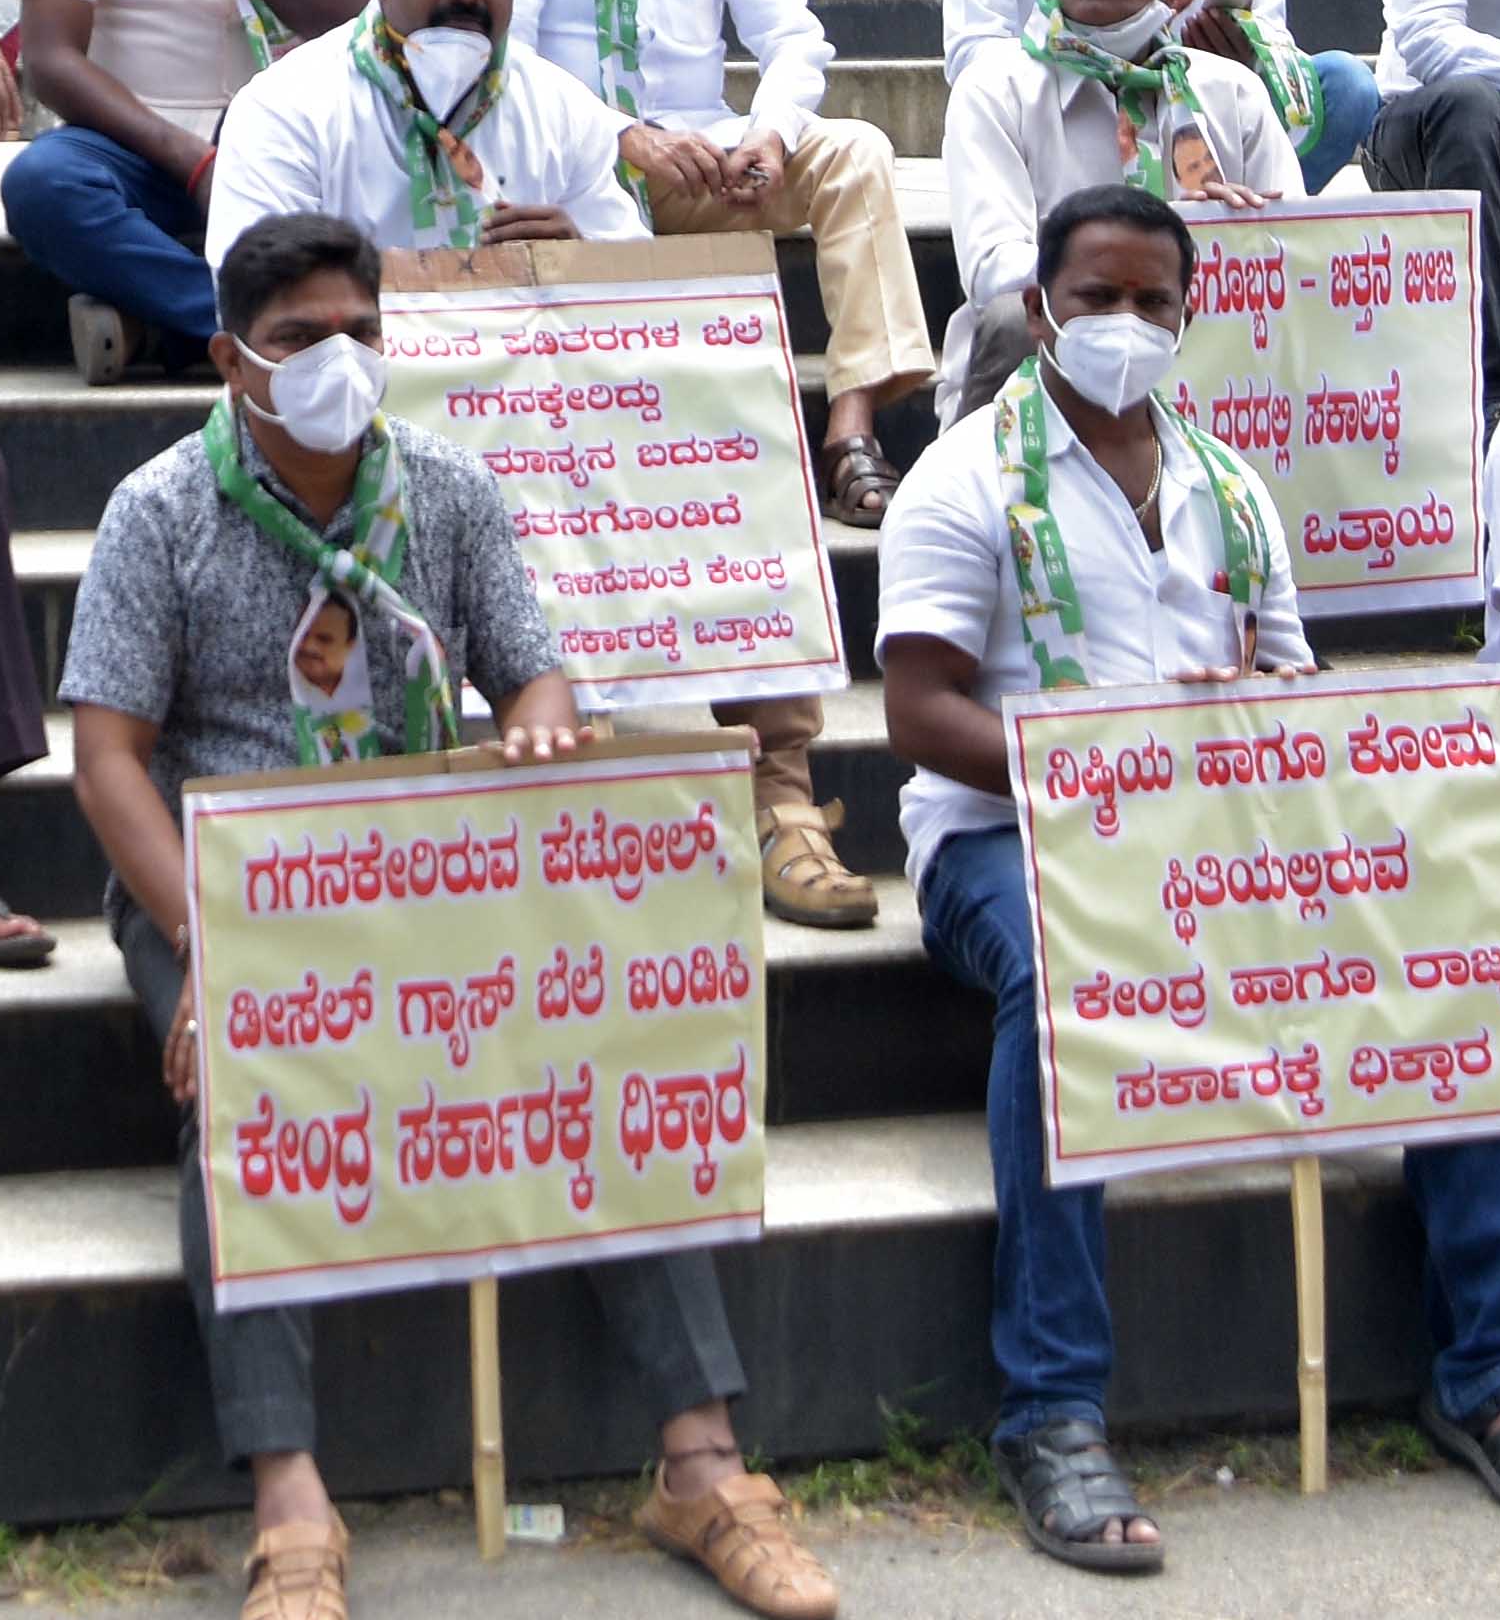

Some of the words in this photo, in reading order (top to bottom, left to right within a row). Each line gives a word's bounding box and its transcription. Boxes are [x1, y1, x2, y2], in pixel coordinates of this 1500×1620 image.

[1330, 236, 1392, 332] ಬಿತ್ತನೆ
[1405, 252, 1457, 304] ಬೀಜ
[504, 325, 680, 357] ಪಡಿತರಗಳ
[704, 316, 763, 346] ಬೆಲೆ
[486, 445, 616, 489] ಮಾನ್ಯನ
[637, 437, 759, 469] ಬದುಕು
[1303, 490, 1455, 570] ಒತ್ತಾಯ
[707, 558, 785, 589] ಕೇಂದ್ರ
[562, 619, 681, 664] ಸರ್ಕಾರಕ್ಕೆ
[696, 615, 793, 652] ಒತ್ತಾಯ
[1196, 720, 1327, 788] ಹಾಗೂ
[1349, 715, 1496, 776] ಕೋಮ
[245, 817, 520, 915] ಗಗನಕೇರಿರುವ
[228, 968, 374, 1052] ಡೀಸೆಲ್
[398, 957, 517, 1068] ಗ್ಯಾಸ್
[537, 945, 607, 1021] ಬೆಲೆ
[627, 944, 752, 1012] ಖಂಡಿಸಿ
[1072, 960, 1207, 1030] ಕೇಂದ್ರ
[1231, 956, 1377, 1008] ಹಾಗೂ
[1116, 1045, 1325, 1120] ಸರ್ಕಾರಕ್ಕೆ
[235, 1083, 374, 1227] ಕೇಂದ್ರ
[398, 1062, 595, 1213] ಸರ್ಕಾರಕ್ಕೆ
